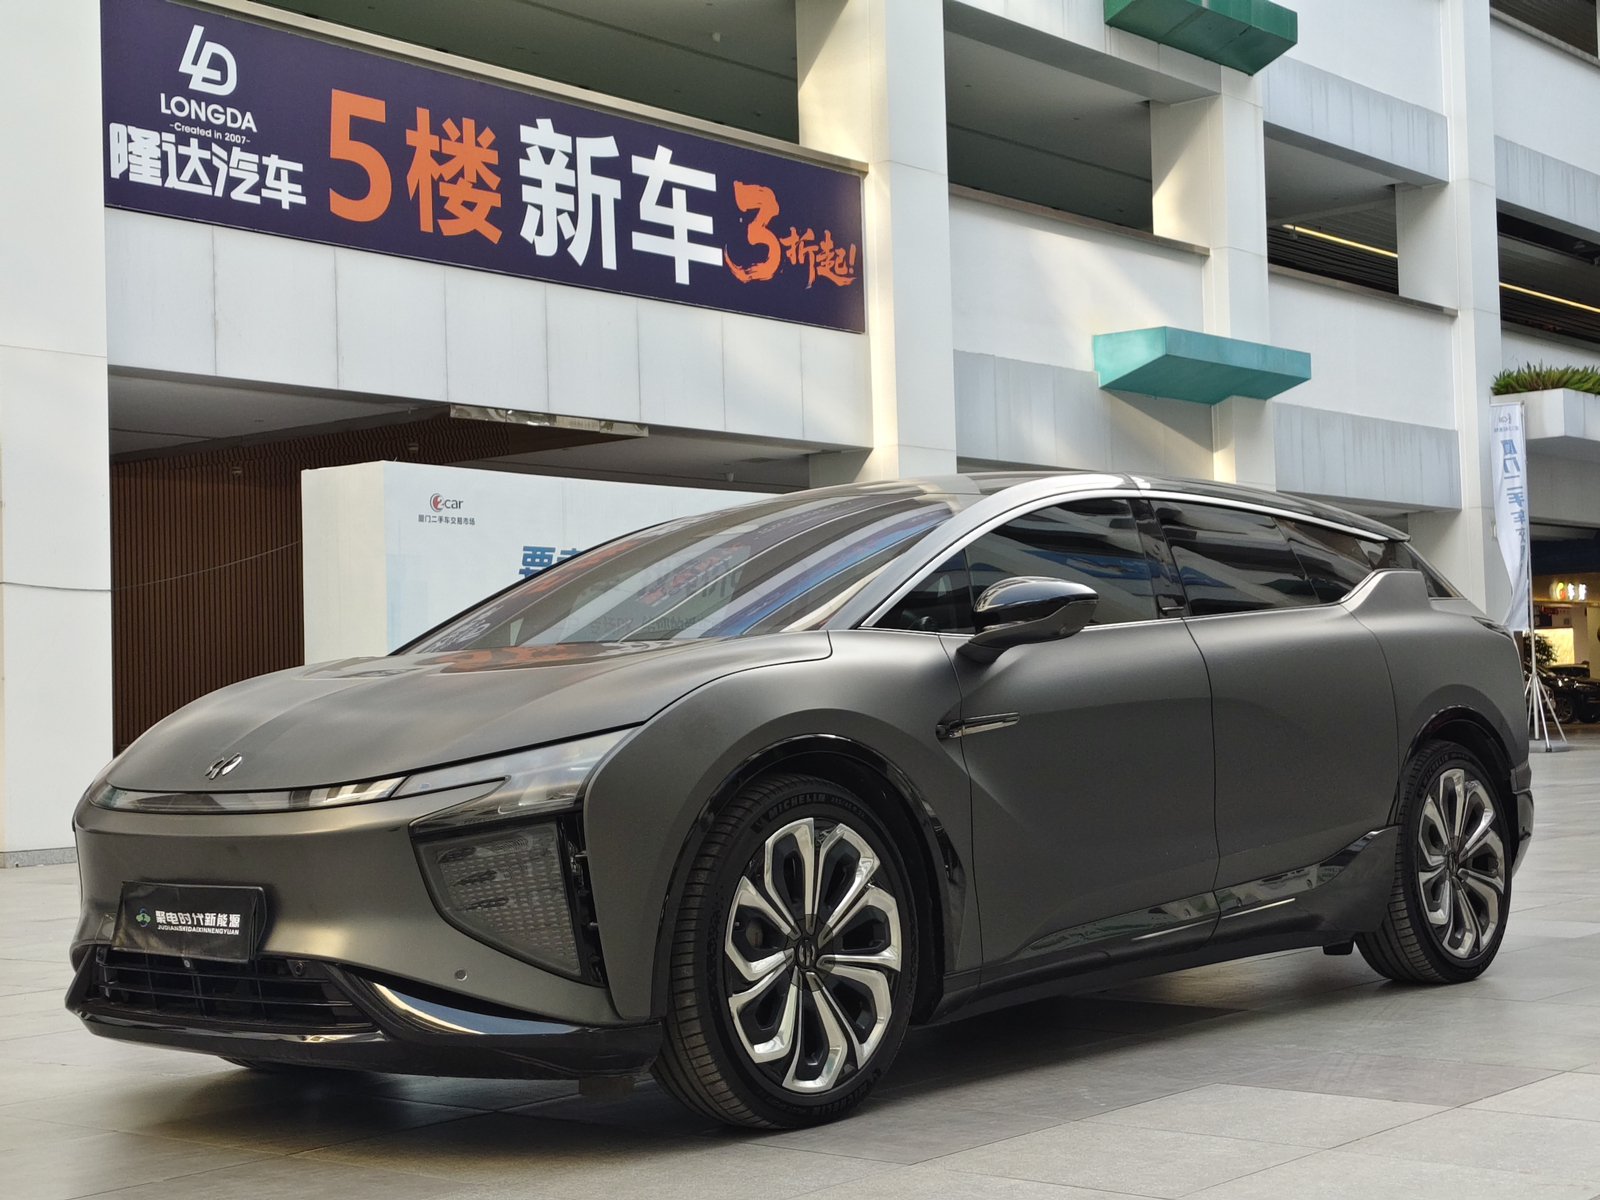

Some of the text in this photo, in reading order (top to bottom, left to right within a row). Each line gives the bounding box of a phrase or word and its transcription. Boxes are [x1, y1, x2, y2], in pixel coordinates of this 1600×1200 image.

[160, 92, 258, 133] LONGDA
[214, 129, 222, 140] in
[109, 122, 307, 210] 隆达汽车
[518, 545, 585, 579] 要
[155, 910, 241, 928] 聚电时代新能源
